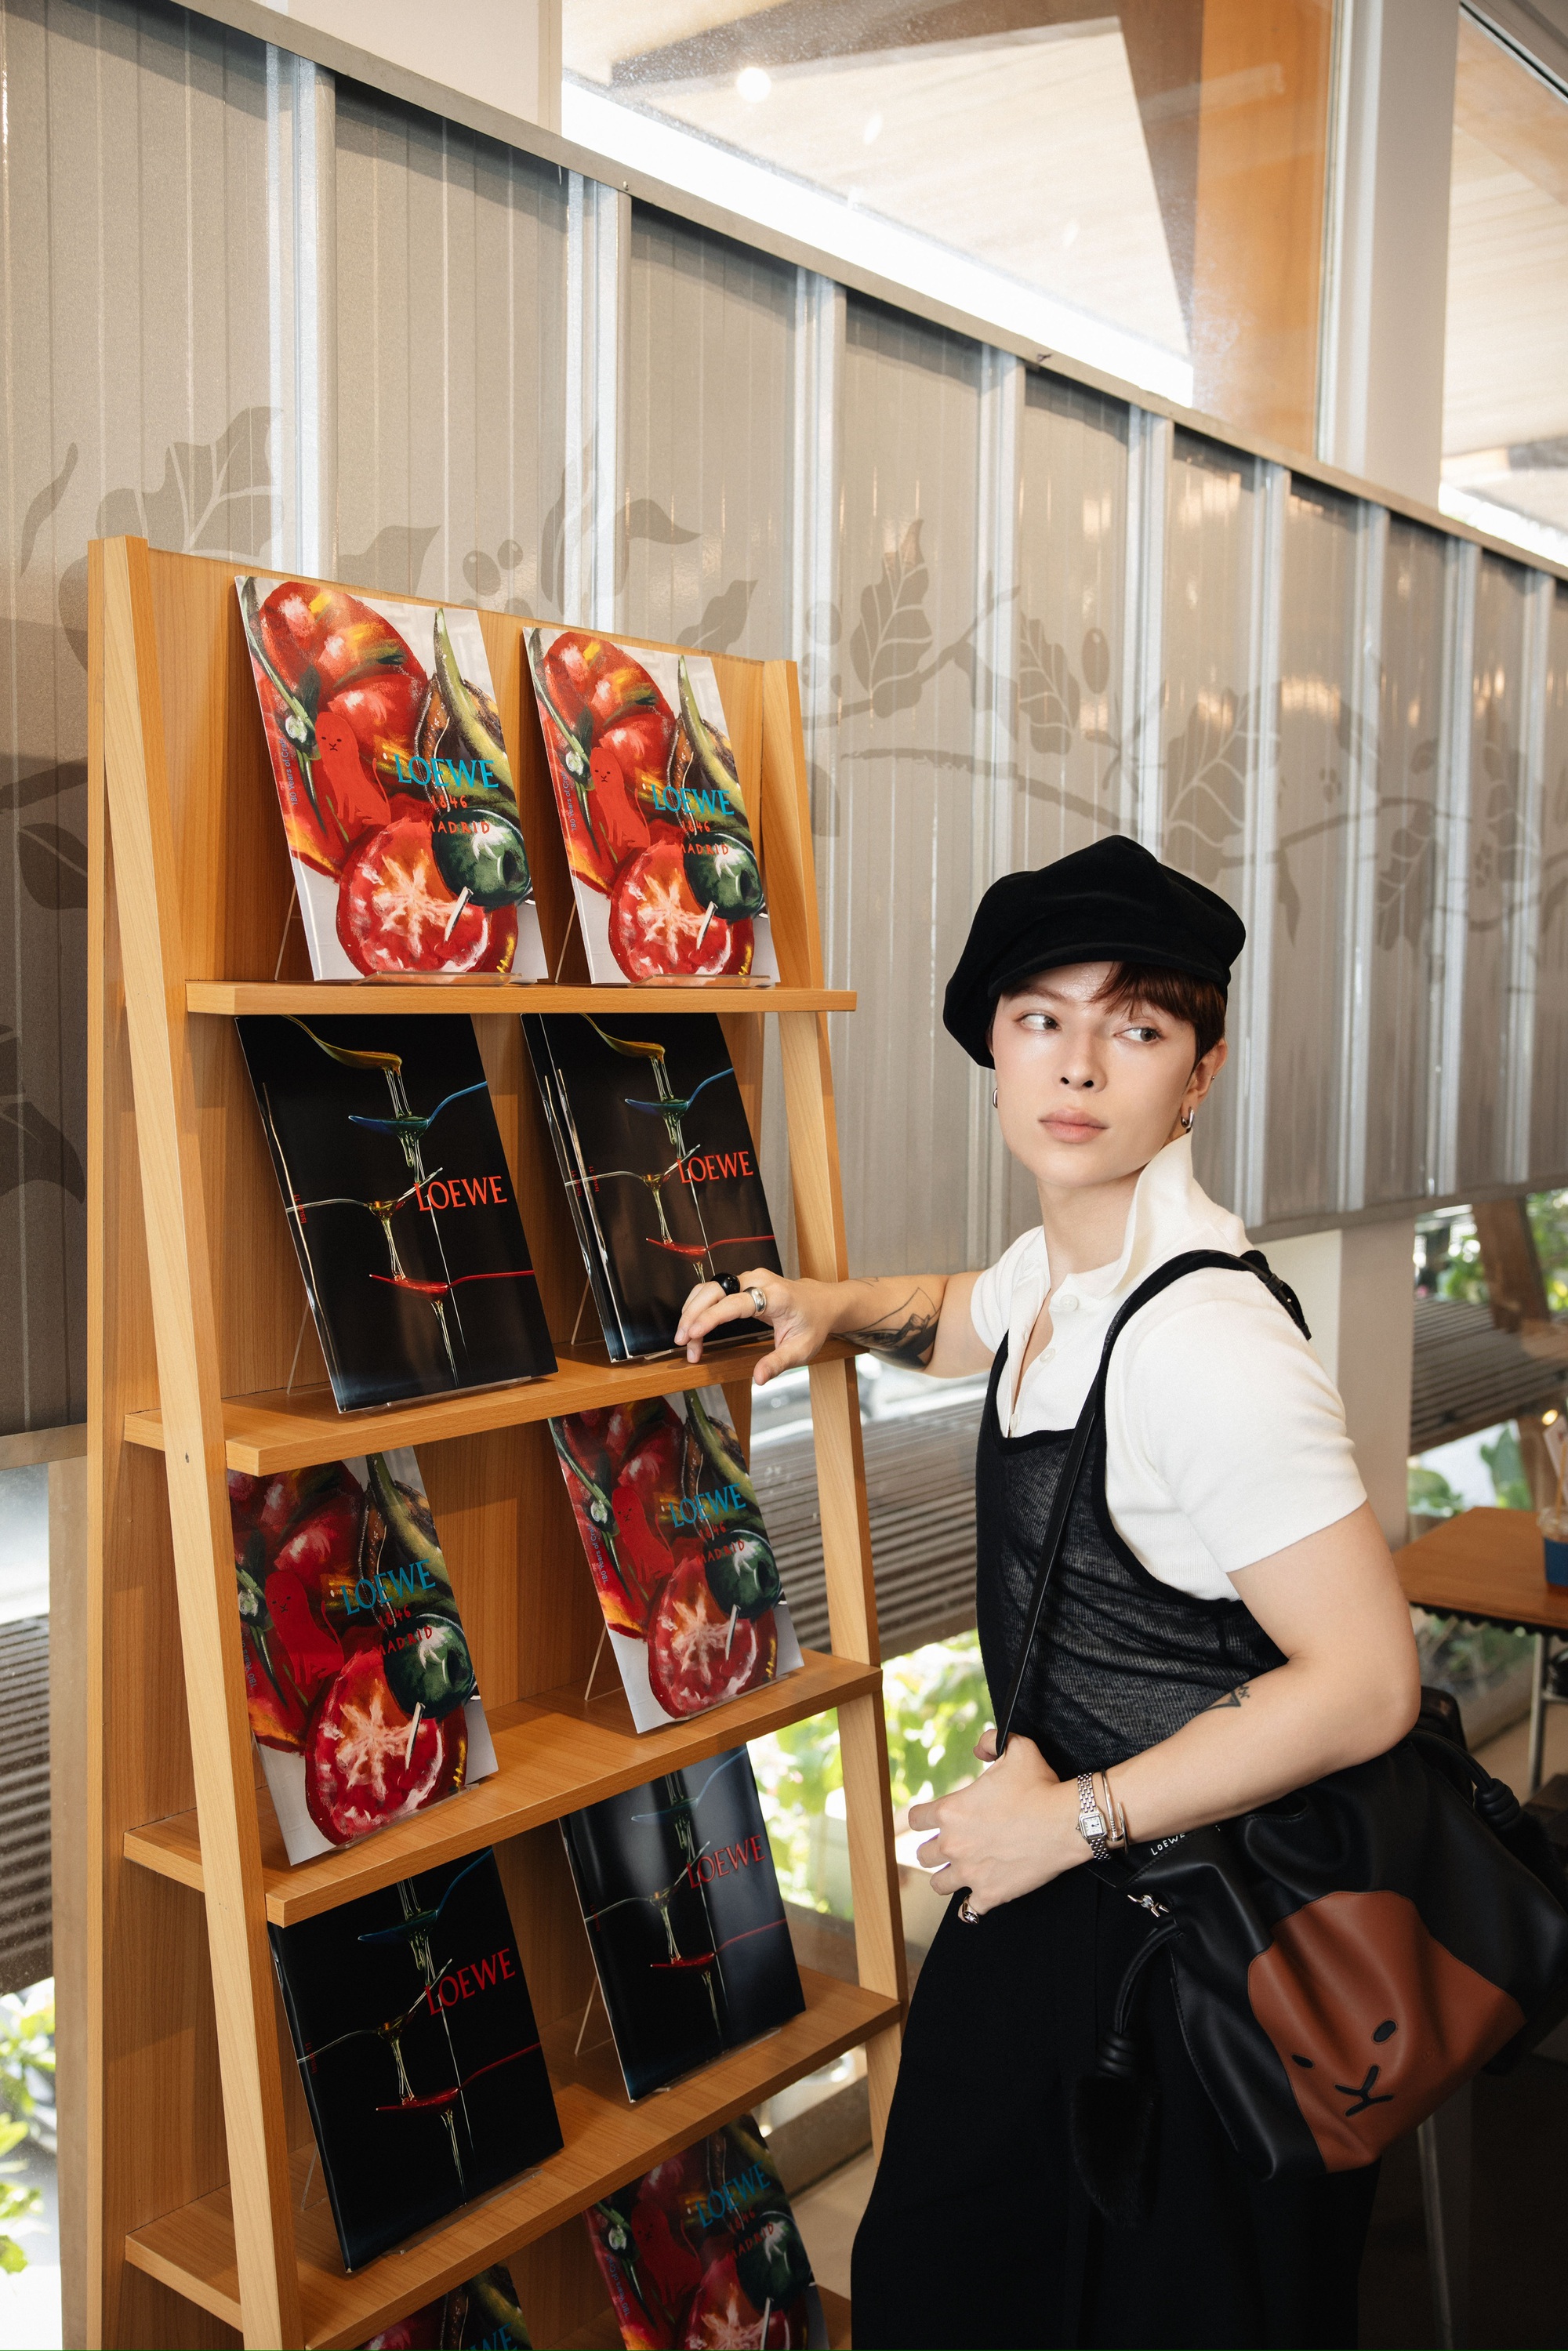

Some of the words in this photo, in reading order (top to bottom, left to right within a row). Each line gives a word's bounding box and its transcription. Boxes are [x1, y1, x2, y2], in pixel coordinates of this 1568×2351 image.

[286, 769, 295, 789] Years
[394, 753, 499, 788] LOEWE
[289, 792, 298, 805] 180
[431, 794, 468, 808] 1846
[651, 784, 735, 815] LOEWE
[681, 820, 710, 833] 1846
[676, 1151, 753, 1184] LOEWE
[413, 1175, 507, 1211] LOEWE
[668, 1482, 746, 1528] LOEWE
[699, 1521, 727, 1541] 1846
[339, 1558, 436, 1616] LOEWE
[379, 1604, 412, 1629] 1846
[1150, 1832, 1185, 1856] LOEWE
[686, 1834, 766, 1889] LOEWE
[424, 1947, 516, 2015] LOEWE
[695, 2161, 771, 2229] LOEWE
